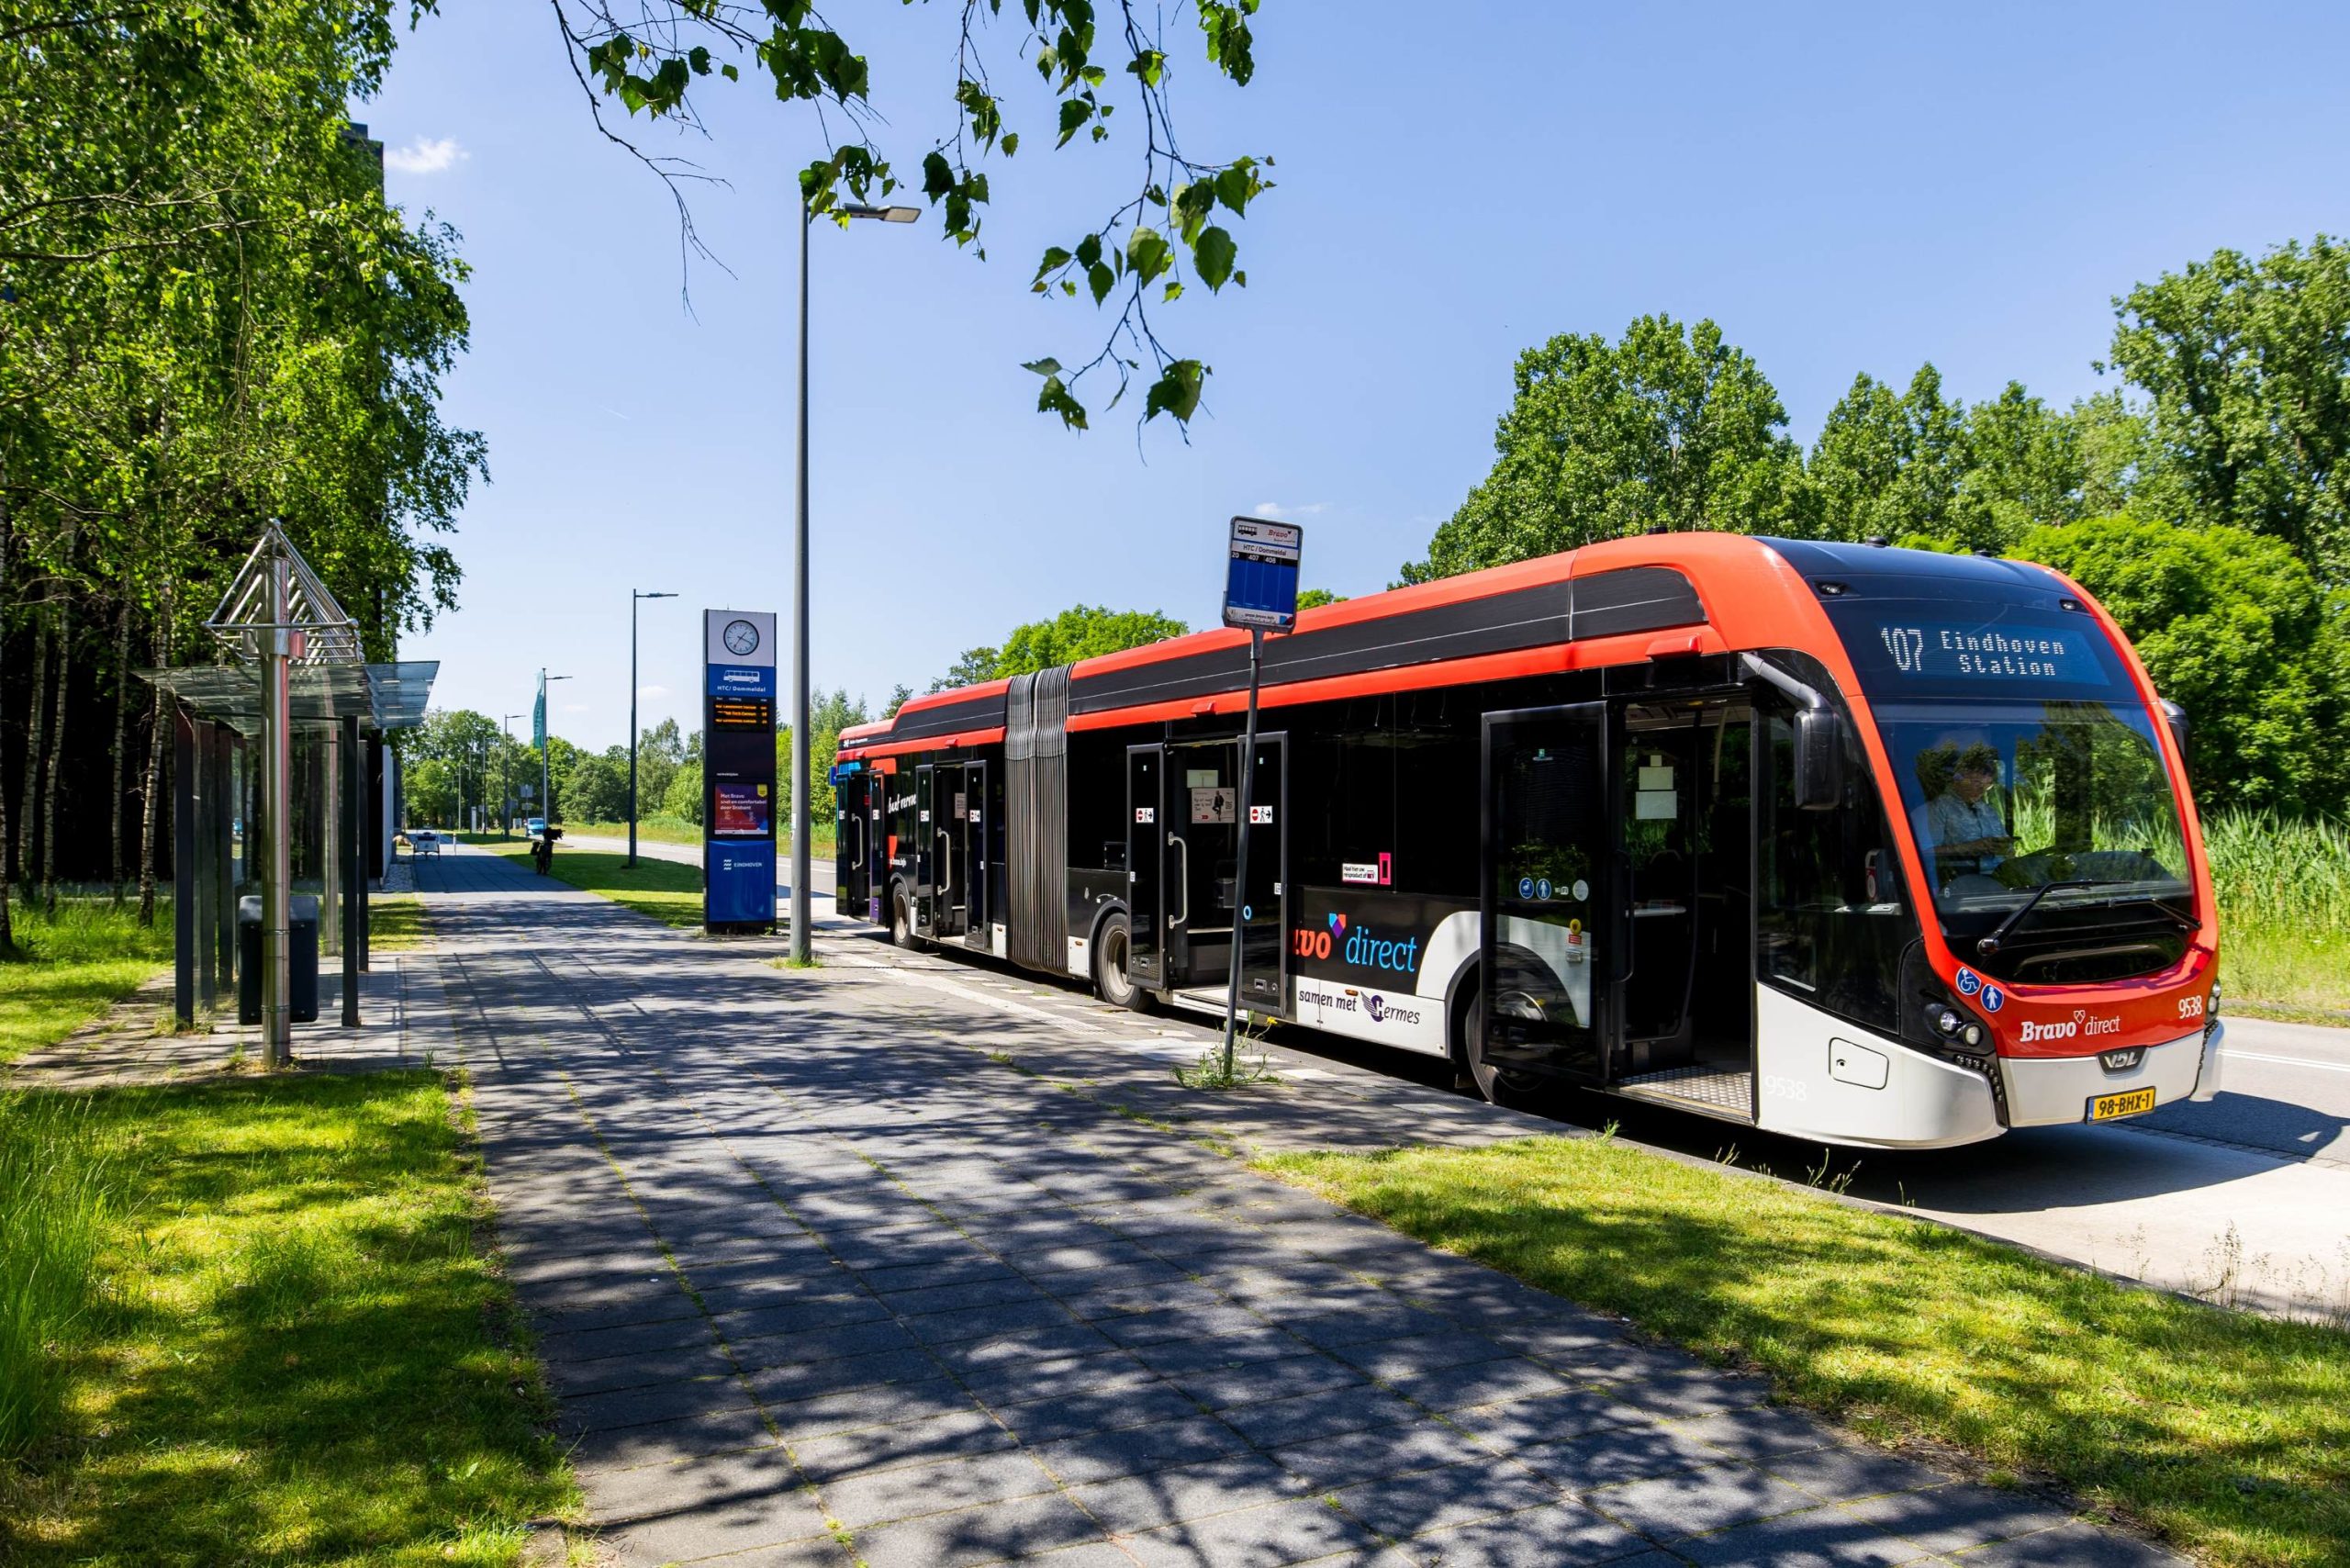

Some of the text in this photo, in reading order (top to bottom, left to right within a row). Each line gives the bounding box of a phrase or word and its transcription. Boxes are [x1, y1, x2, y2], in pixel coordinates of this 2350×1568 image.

[1268, 529, 1288, 538] Bravo
[1881, 627, 1923, 672] 107
[1941, 631, 2065, 655] Eindhoven
[1959, 655, 2056, 676] Station
[1346, 925, 1417, 972] direct
[1299, 990, 1333, 1007] samen
[1336, 996, 1357, 1012] met
[2178, 995, 2202, 1019] 9538
[2020, 1014, 2121, 1043] Bravo direct
[2104, 1051, 2138, 1069] VDL
[1764, 1075, 1807, 1102] 9538
[2098, 1092, 2150, 1116] 98-BHX-1
